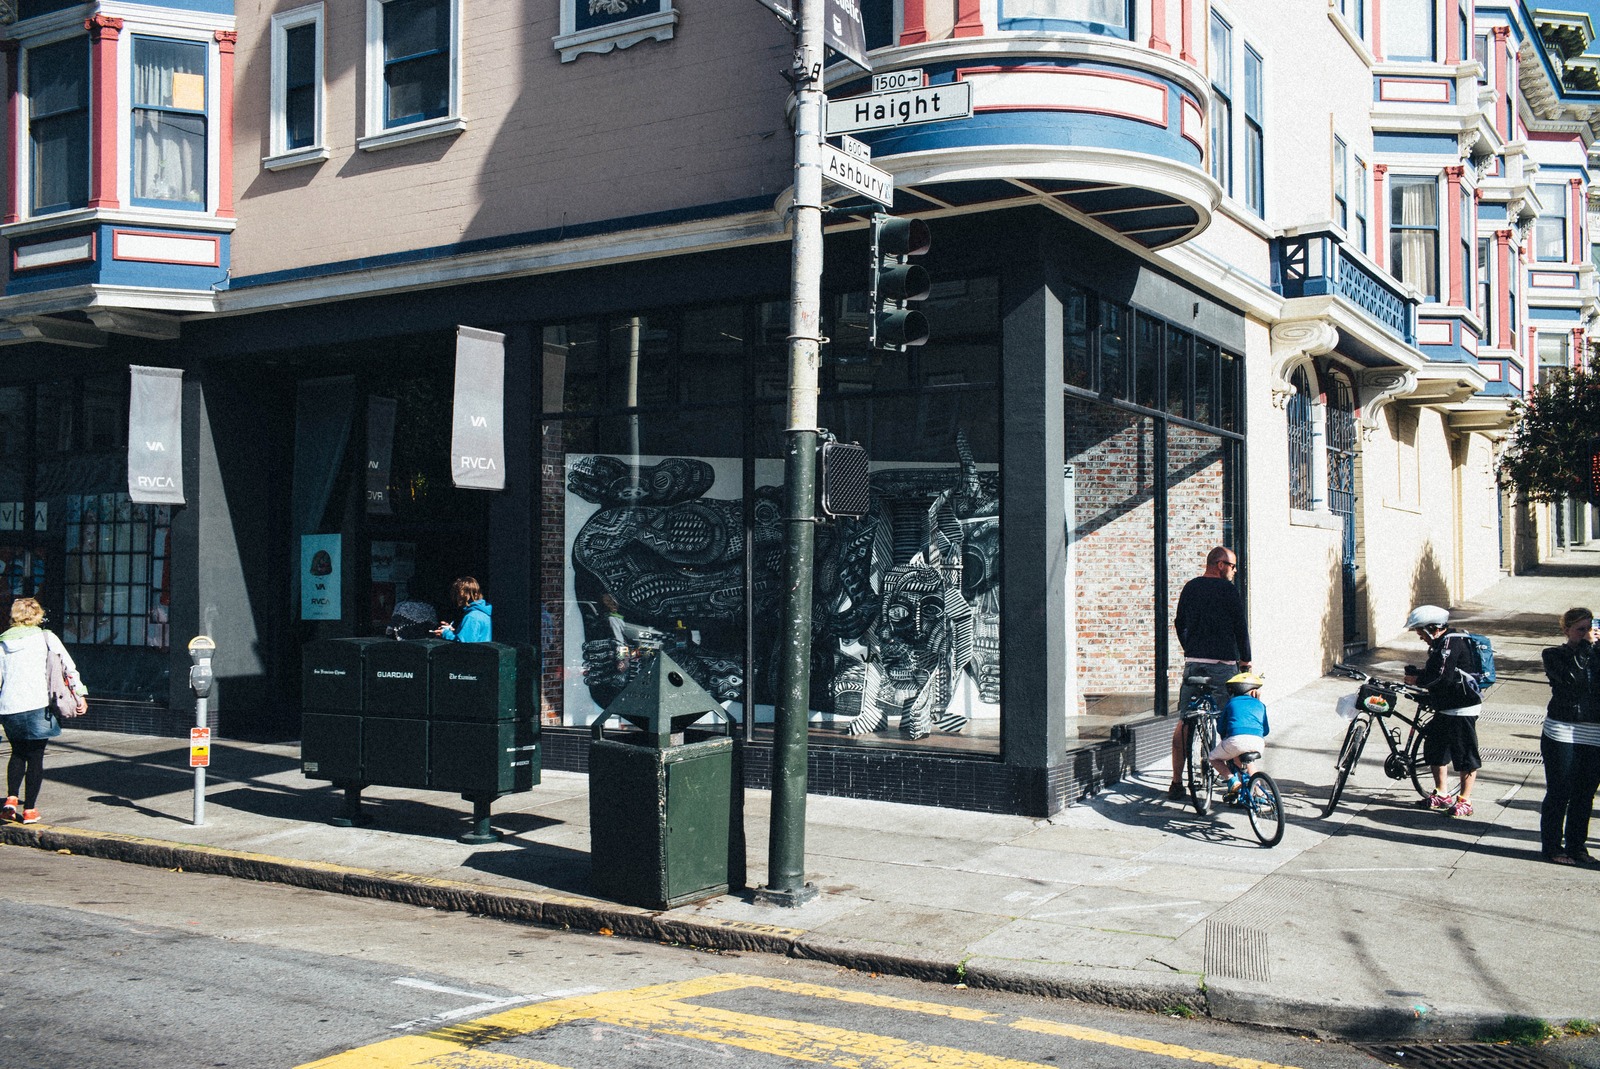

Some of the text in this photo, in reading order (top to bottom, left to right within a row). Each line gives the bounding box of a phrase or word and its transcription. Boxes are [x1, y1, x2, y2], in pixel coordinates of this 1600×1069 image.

[875, 74, 906, 91] 1500
[855, 92, 941, 123] Haight
[848, 141, 862, 157] 600
[829, 155, 885, 199] Ashbury
[461, 456, 497, 470] RVCA
[137, 476, 176, 488] RVCA
[376, 671, 414, 679] GUARDIAN
